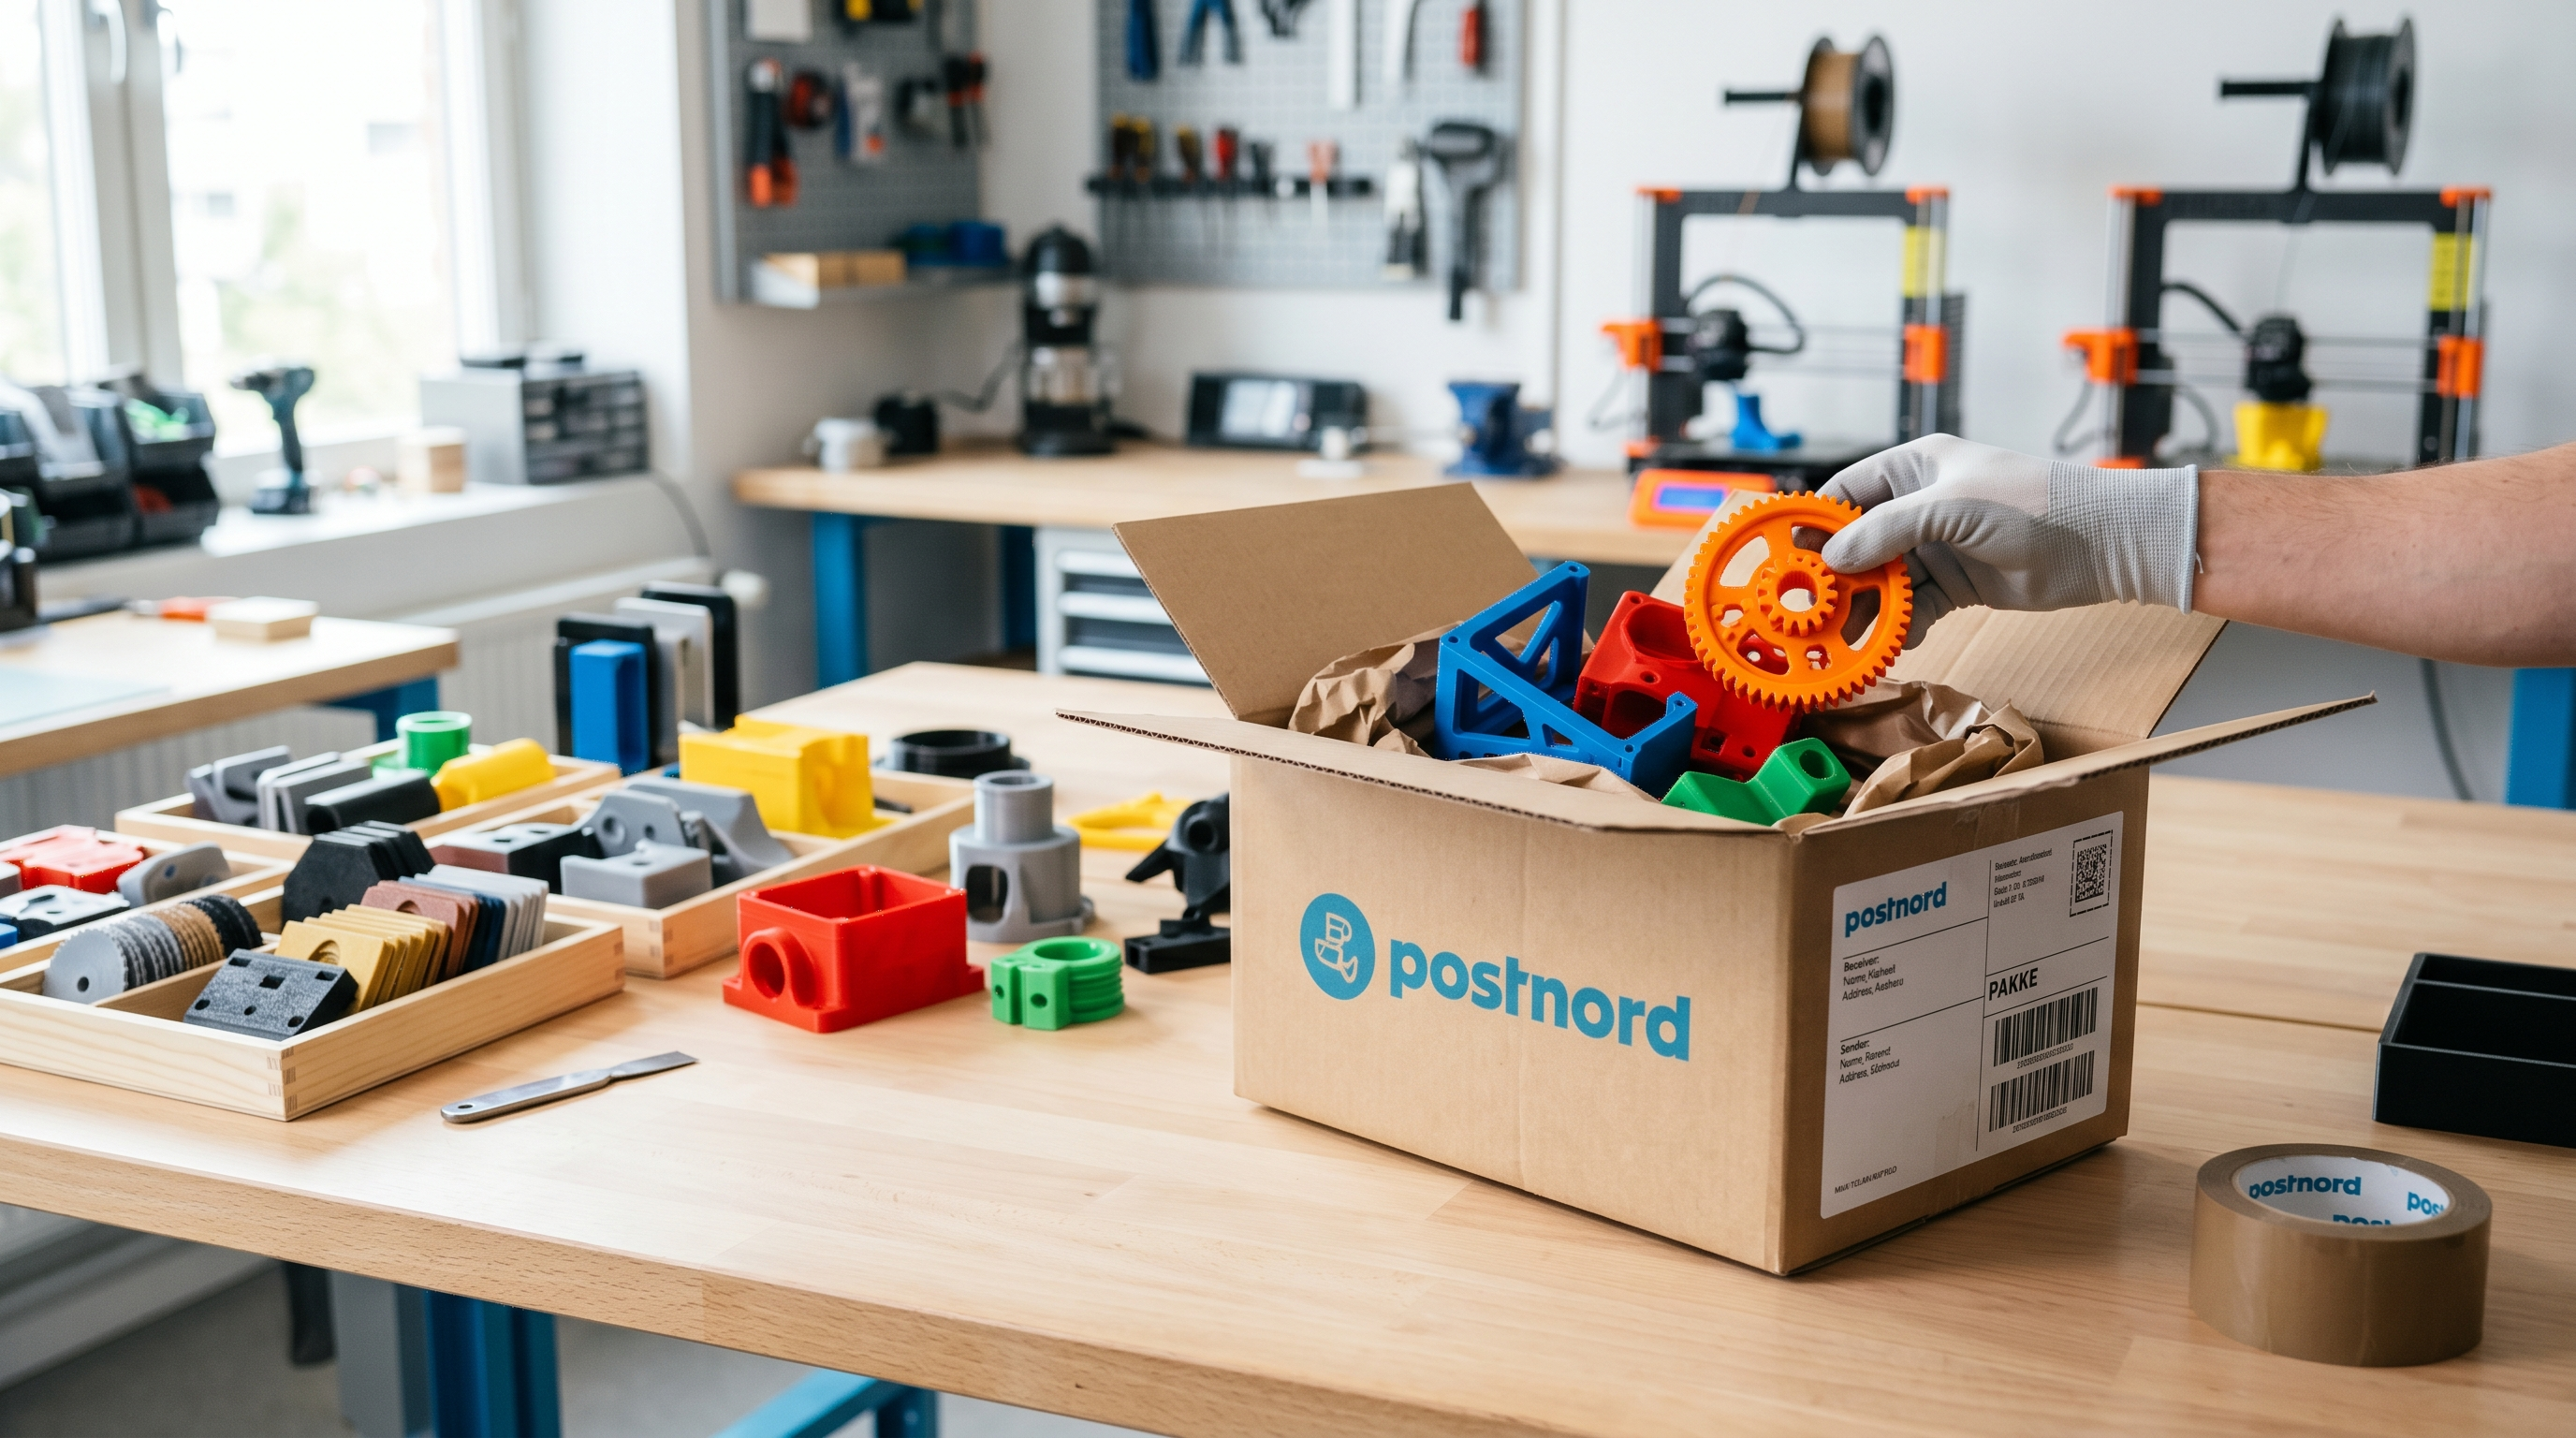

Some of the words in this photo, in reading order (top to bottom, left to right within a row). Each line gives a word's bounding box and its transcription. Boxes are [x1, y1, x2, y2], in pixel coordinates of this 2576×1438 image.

[1845, 881, 1947, 938] postnord
[1389, 938, 1691, 1063] postnord
[1988, 967, 2039, 1001] PAKKE
[1840, 1040, 1870, 1055] Sender:
